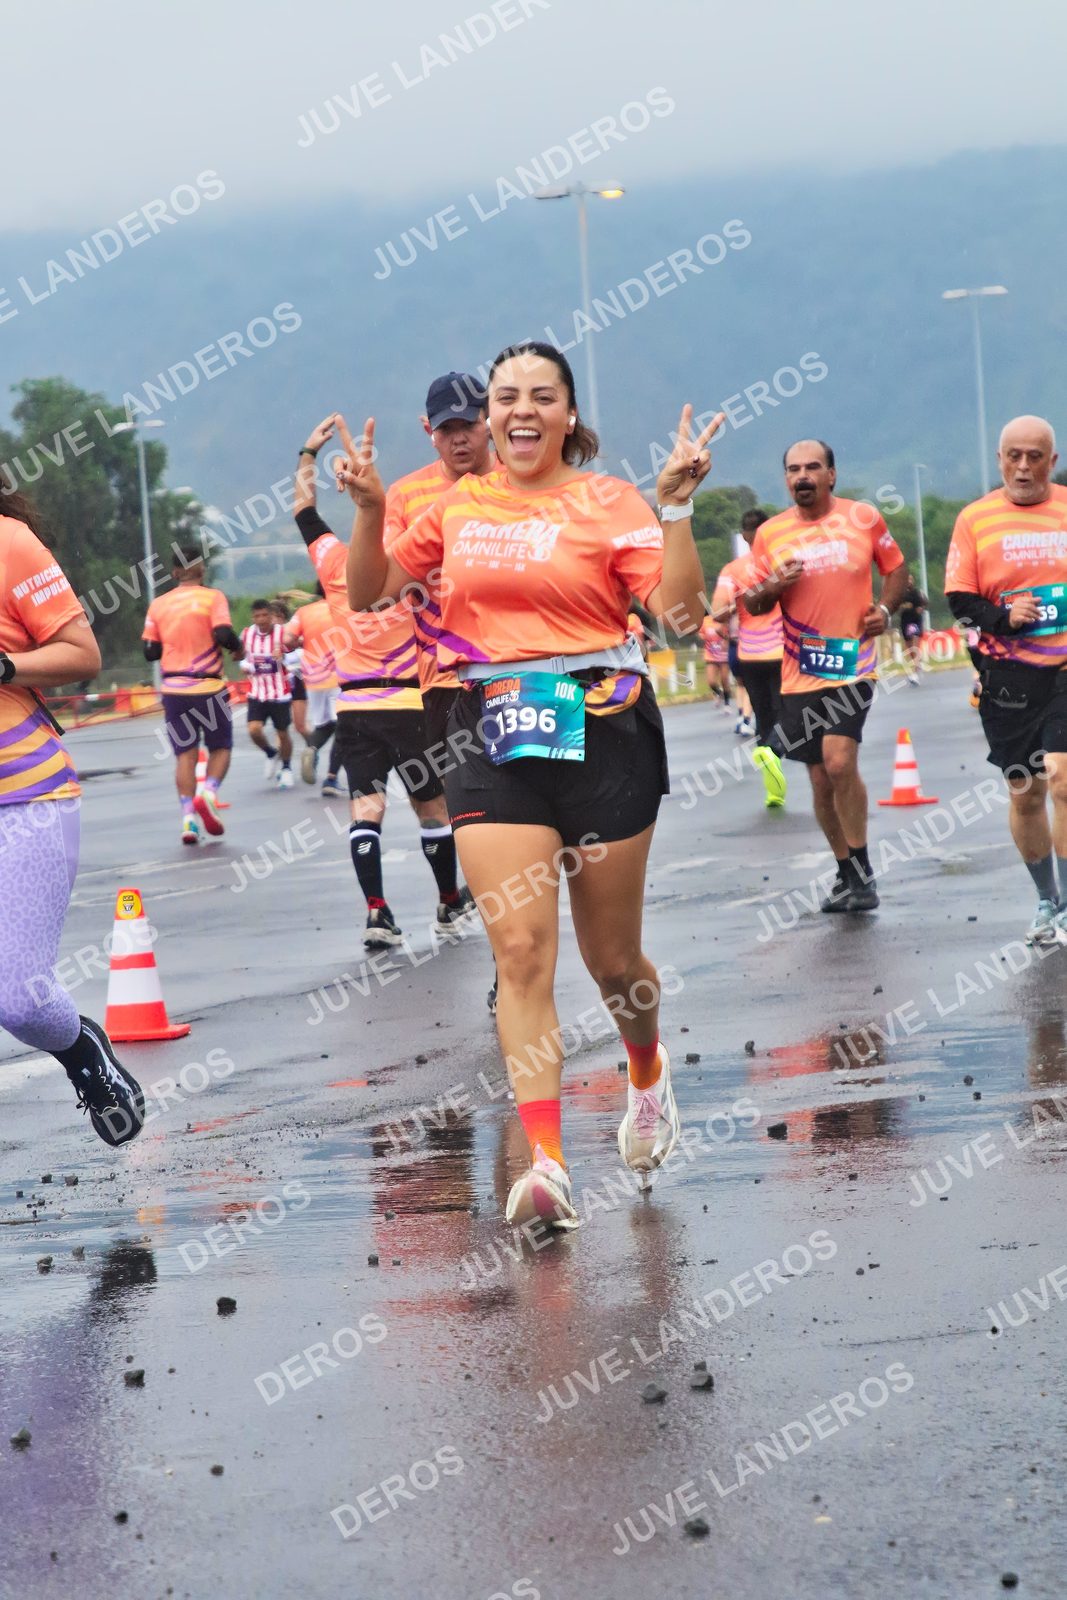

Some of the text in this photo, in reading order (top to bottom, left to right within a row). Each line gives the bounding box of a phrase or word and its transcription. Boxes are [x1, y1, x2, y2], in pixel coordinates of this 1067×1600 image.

[452, 541, 528, 559] OMNILIFE
[809, 652, 844, 669] 1723
[555, 681, 577, 701] 10K
[496, 706, 556, 735] 1396
